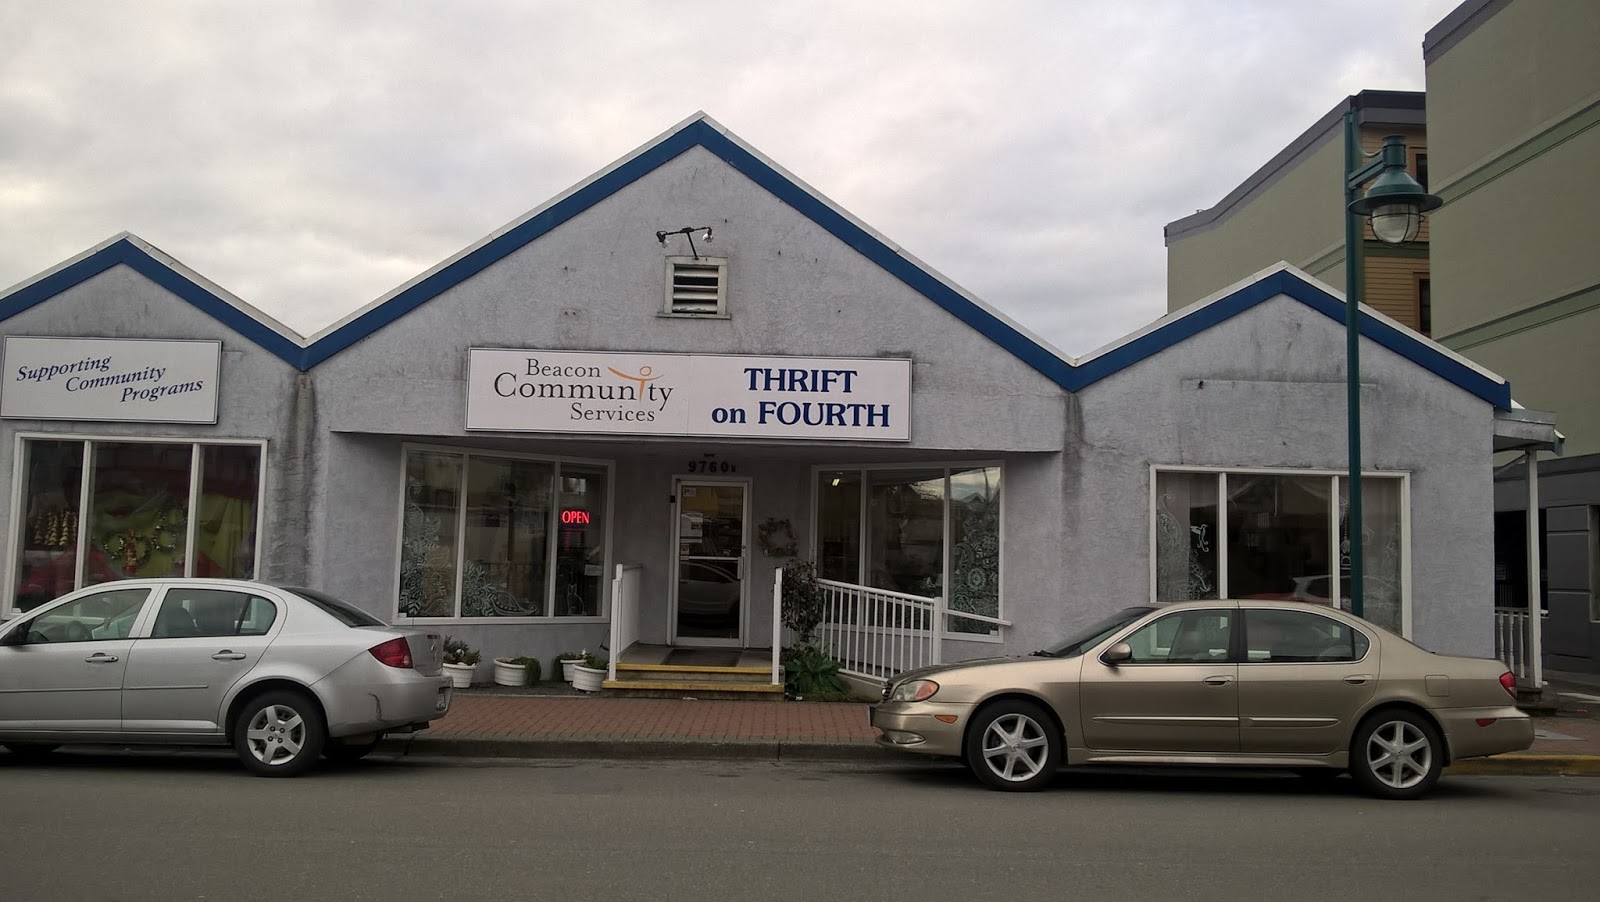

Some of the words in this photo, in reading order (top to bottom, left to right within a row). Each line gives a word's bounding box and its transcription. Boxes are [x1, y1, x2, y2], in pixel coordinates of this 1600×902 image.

[16, 355, 112, 382] Supporting
[65, 366, 166, 392] Community
[525, 358, 601, 378] Beacon
[744, 367, 858, 393] THRIFT
[120, 380, 204, 403] Programs
[494, 366, 674, 412] Community
[570, 402, 655, 422] Services
[711, 407, 747, 424] on
[758, 401, 890, 428] FOURTH
[561, 510, 590, 524] OPEN
